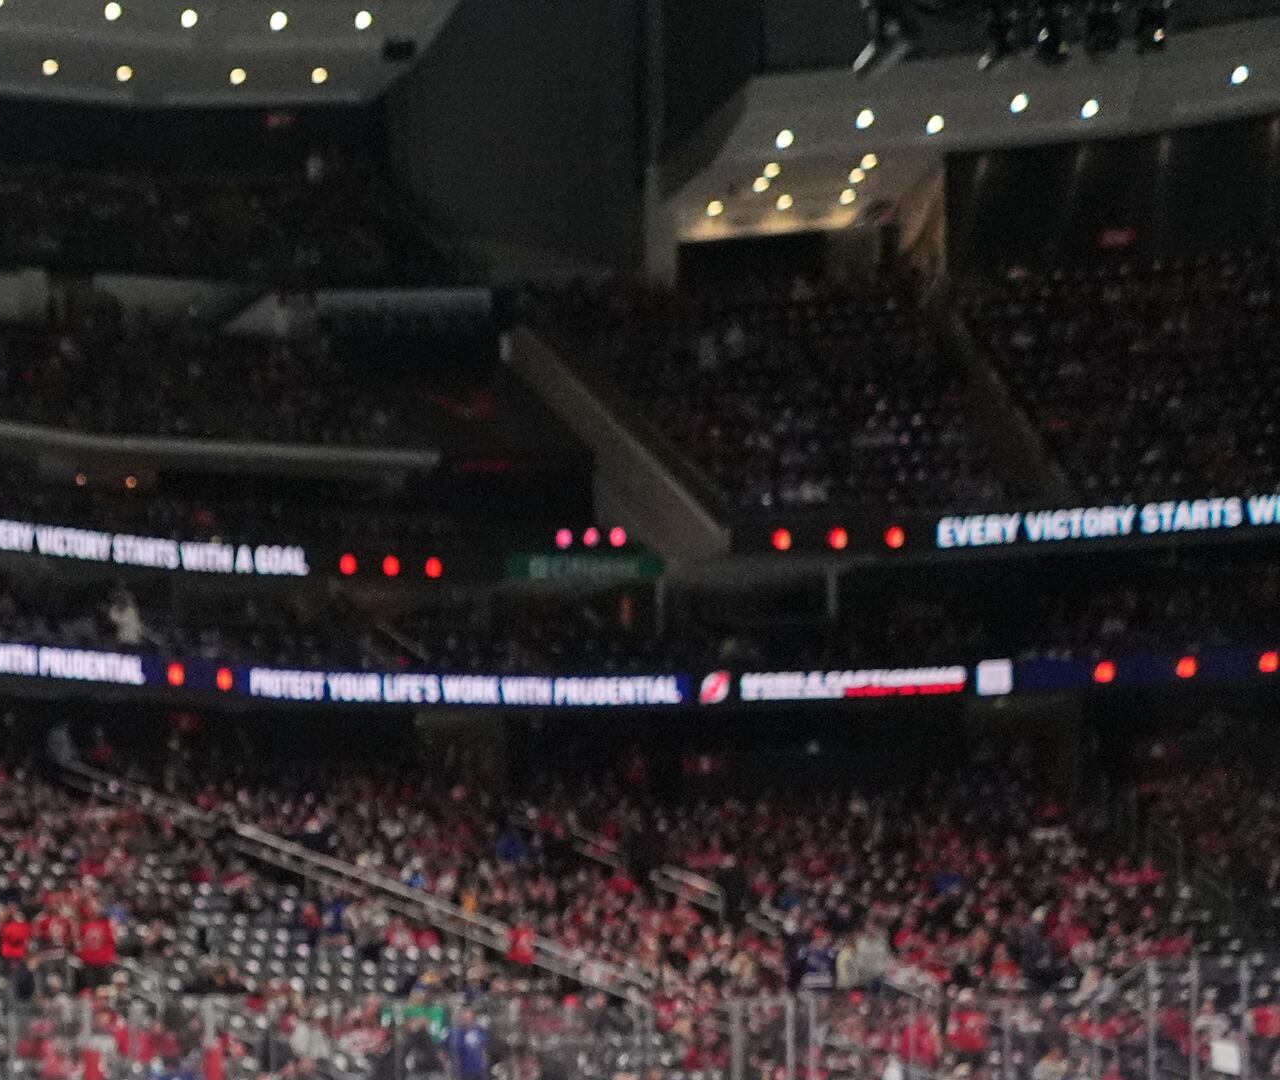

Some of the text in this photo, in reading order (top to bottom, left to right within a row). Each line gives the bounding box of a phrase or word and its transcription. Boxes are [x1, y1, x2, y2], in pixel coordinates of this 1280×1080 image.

[938, 513, 1020, 547] EVERY
[1024, 505, 1136, 541] VICTORY
[1140, 498, 1242, 533] STARTS
[36, 526, 112, 561] VICTORY
[112, 534, 180, 569] STARTS
[180, 542, 234, 572] WITH
[235, 545, 254, 573] A
[255, 546, 308, 575] GOAL
[39, 647, 145, 685] PRUDENTIAL
[250, 668, 680, 705] PROTECT YOUR LIFE'S WORK WITH PRUDENTIAL
